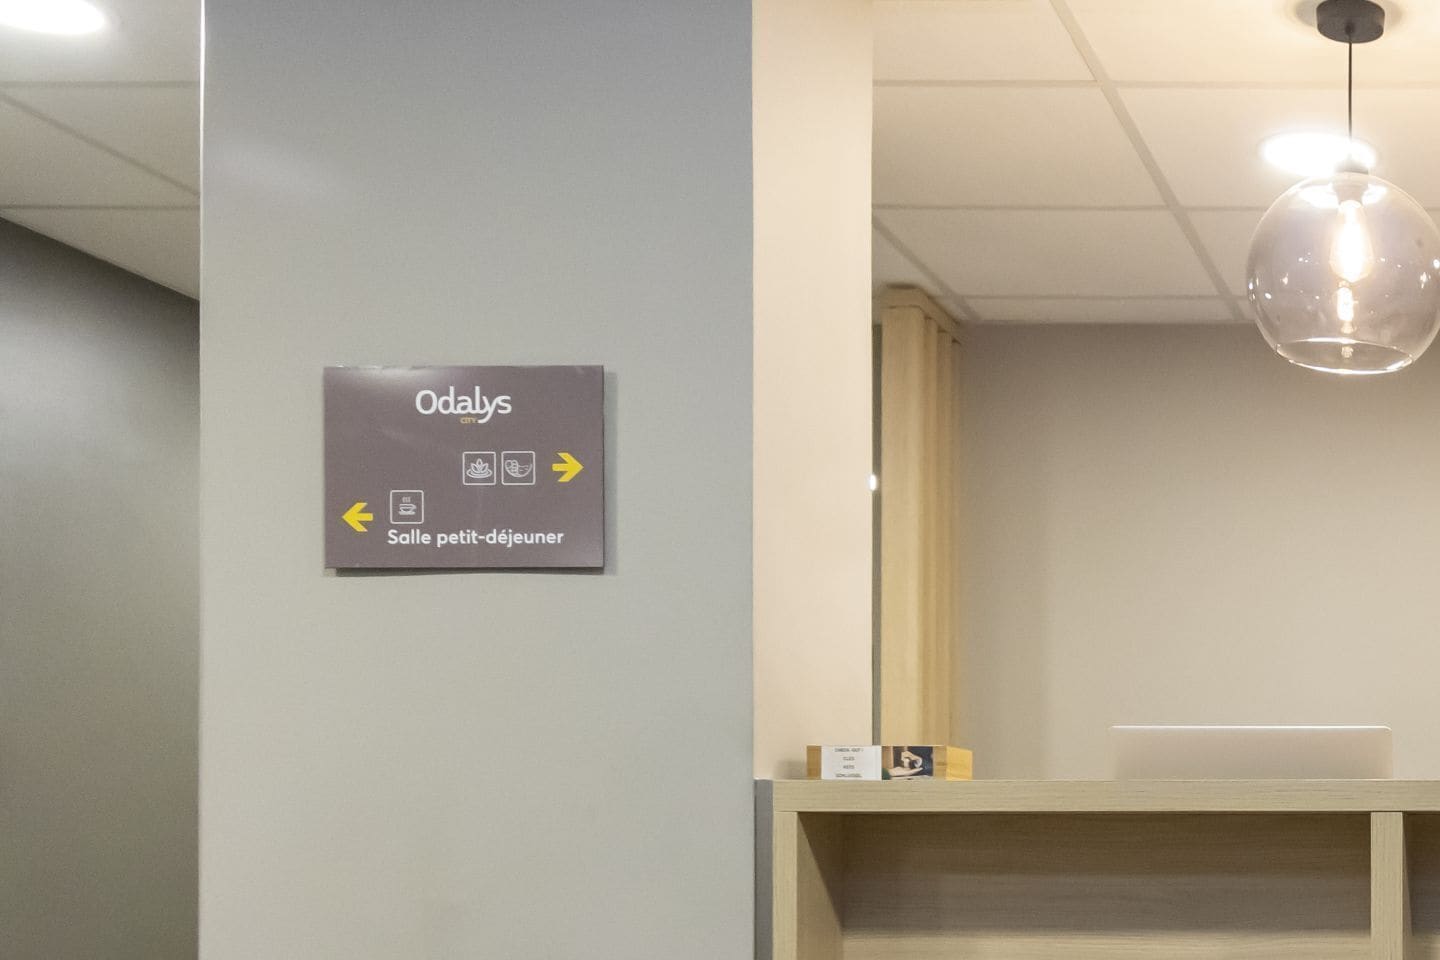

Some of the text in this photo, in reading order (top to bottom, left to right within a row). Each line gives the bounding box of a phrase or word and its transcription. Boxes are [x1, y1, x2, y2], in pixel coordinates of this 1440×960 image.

[415, 385, 512, 424] Odalys
[387, 529, 564, 547] Salle petit-déjeuner
